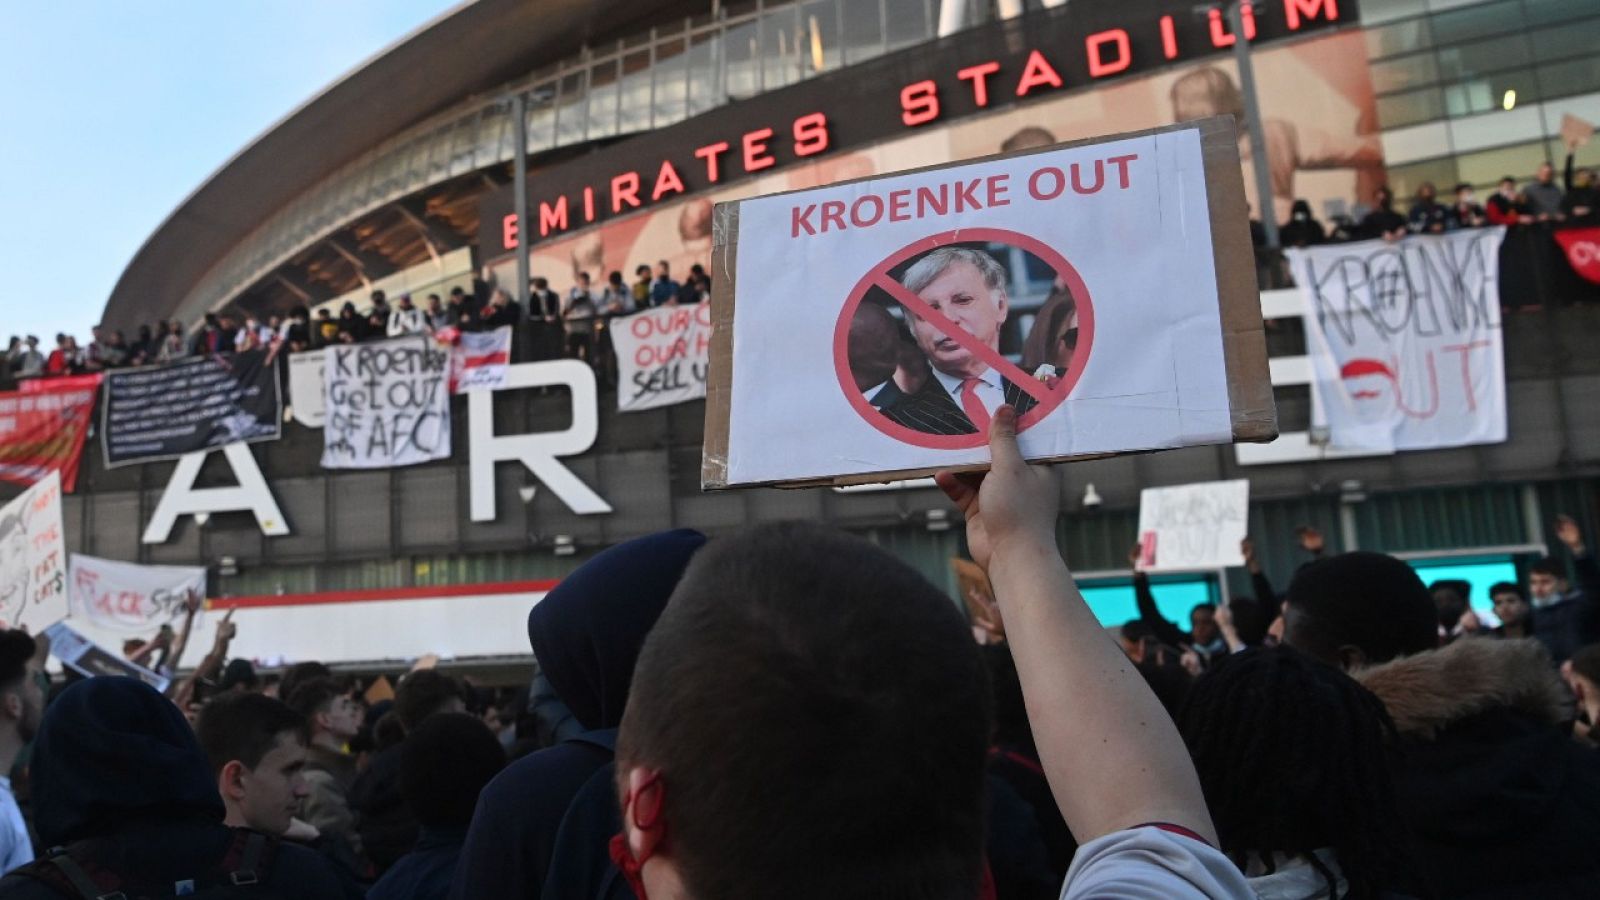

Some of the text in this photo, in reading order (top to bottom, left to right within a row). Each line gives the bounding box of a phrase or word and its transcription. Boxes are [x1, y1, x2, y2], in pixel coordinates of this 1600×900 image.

[503, 0, 1338, 250] EMIRATES STADIUM
[791, 154, 1139, 238] KROENKE OUT
[1305, 232, 1503, 346] KROENKE
[631, 309, 690, 339] OUR
[635, 337, 688, 367] OUR
[388, 377, 442, 409] OUT
[633, 363, 690, 398] SELL
[367, 410, 440, 458] AFC
